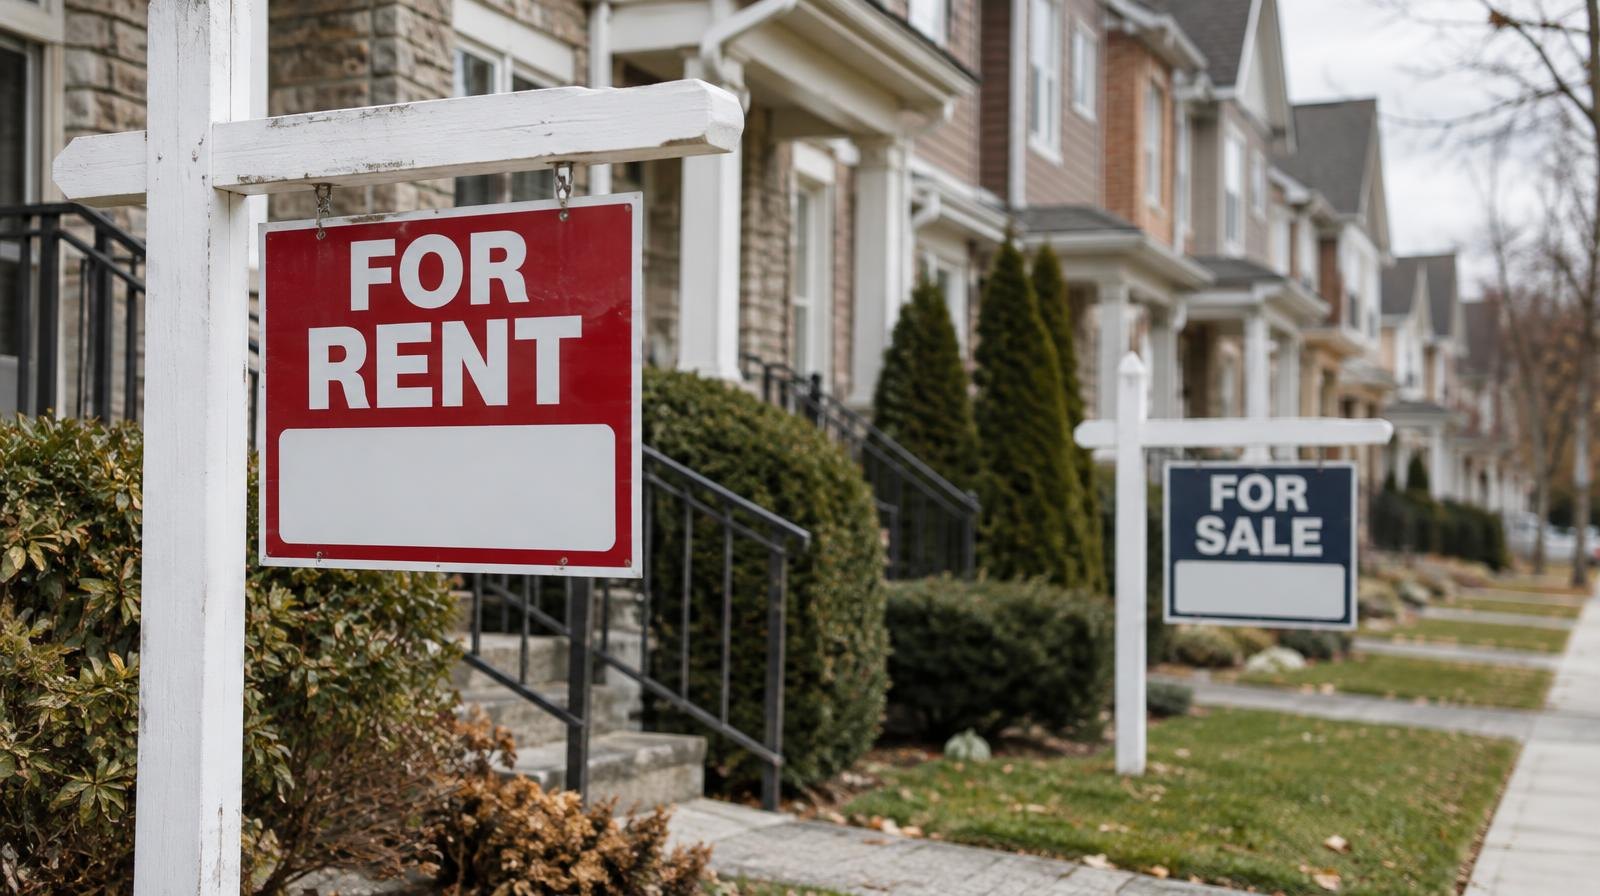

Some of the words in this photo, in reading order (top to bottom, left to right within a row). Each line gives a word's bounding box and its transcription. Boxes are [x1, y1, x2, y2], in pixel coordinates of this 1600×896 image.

[351, 231, 529, 311] FOR
[309, 315, 582, 409] RENT
[1211, 474, 1308, 511] FOR
[1197, 516, 1323, 556] SALE
